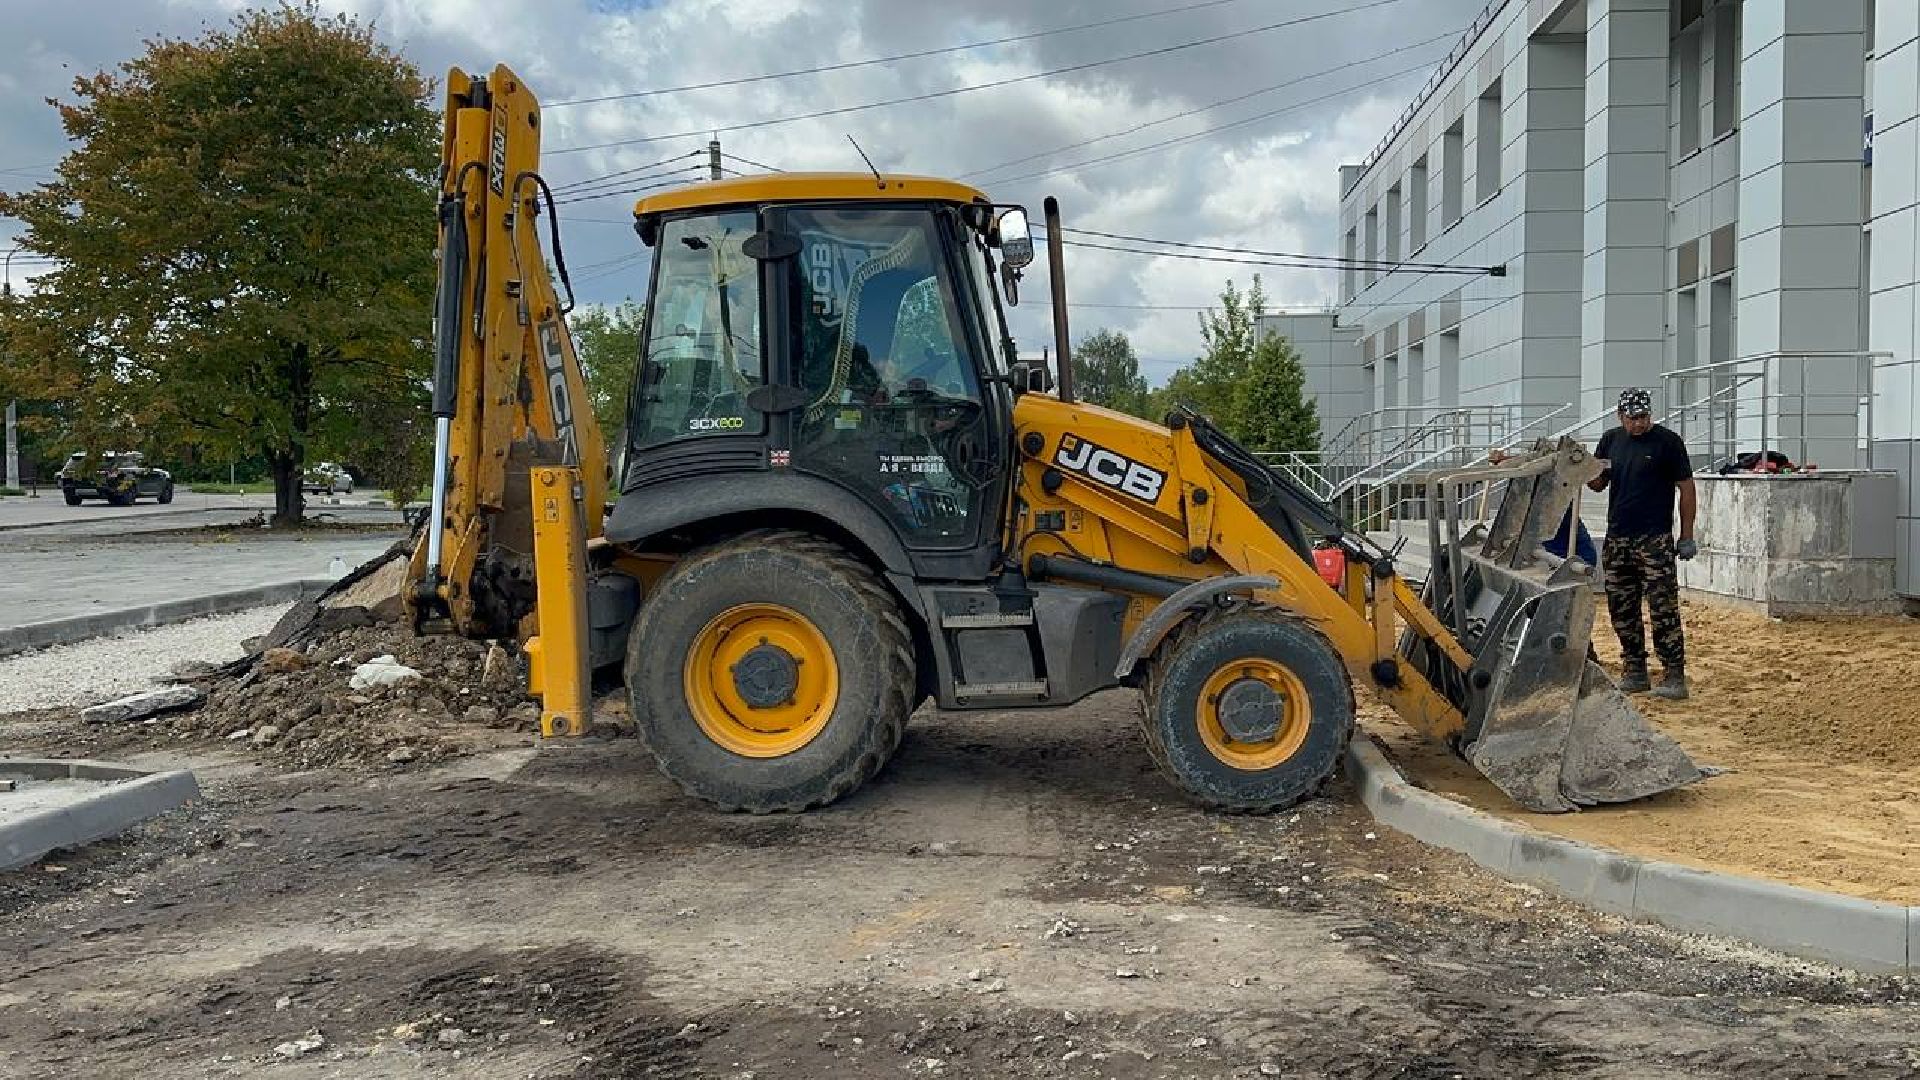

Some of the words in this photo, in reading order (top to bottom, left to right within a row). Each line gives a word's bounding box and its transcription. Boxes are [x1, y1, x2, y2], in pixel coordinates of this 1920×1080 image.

[812, 244, 831, 314] JCB
[879, 463, 889, 473] А
[892, 463, 899, 473] Я
[911, 463, 944, 474] ВЕЗДЕ
[1058, 438, 1162, 500] JCB
